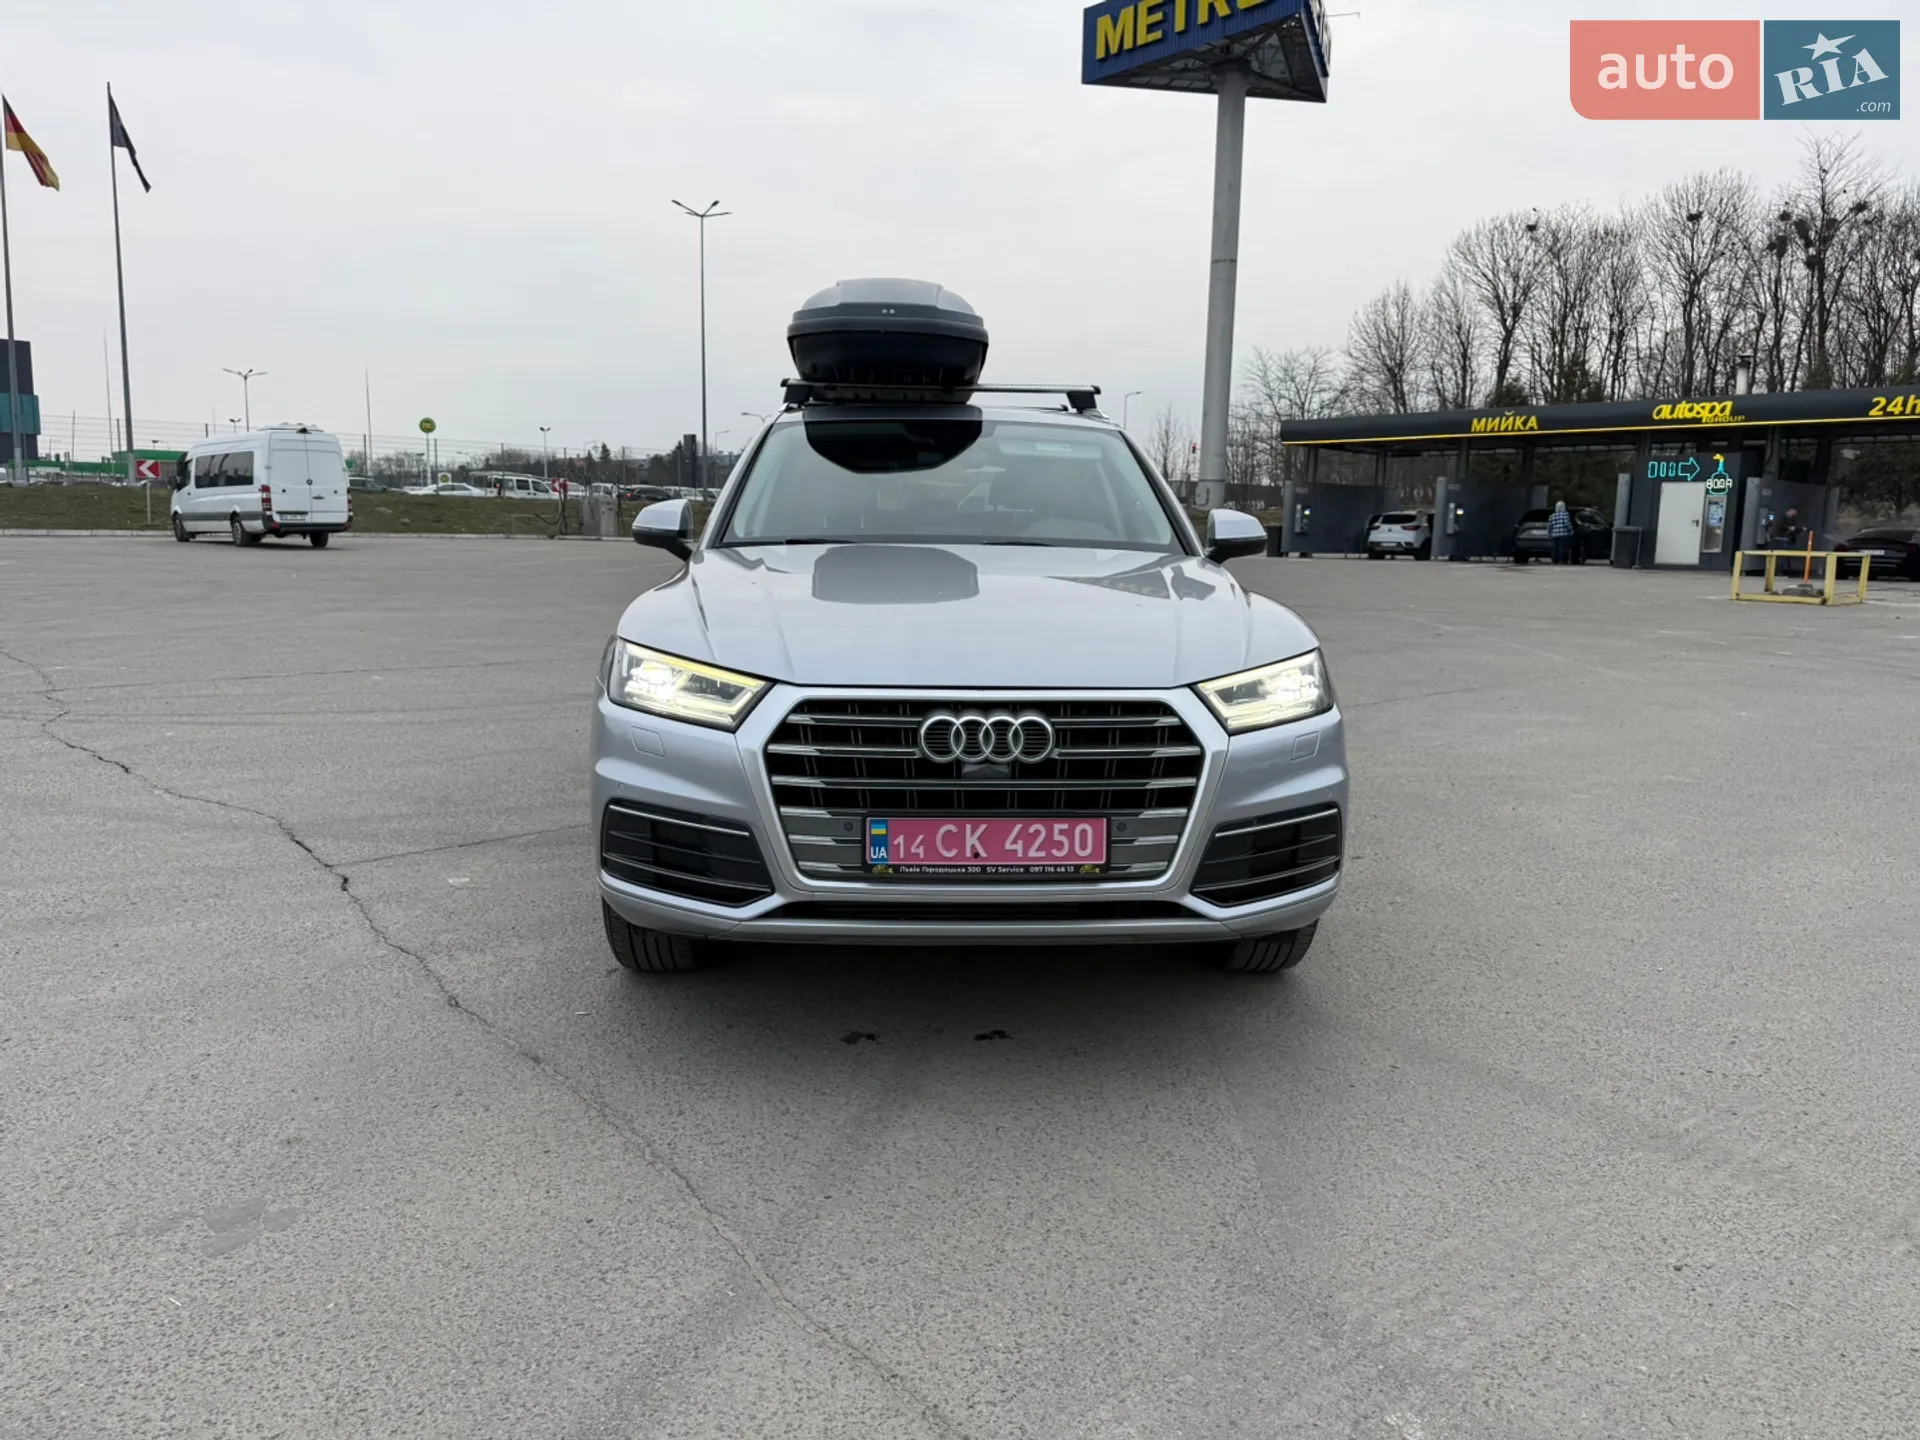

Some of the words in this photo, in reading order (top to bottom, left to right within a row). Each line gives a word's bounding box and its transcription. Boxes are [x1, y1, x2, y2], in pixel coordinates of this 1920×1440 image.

[1095, 0, 1266, 60] METR
[1652, 400, 1734, 423] autospa
[1868, 394, 1920, 416] 24h
[1471, 411, 1539, 433] МИЙКА
[893, 834, 925, 859] 14
[1004, 823, 1094, 858] 4250
[870, 846, 888, 859] UA
[967, 866, 981, 874] 300
[998, 865, 1025, 873] Service
